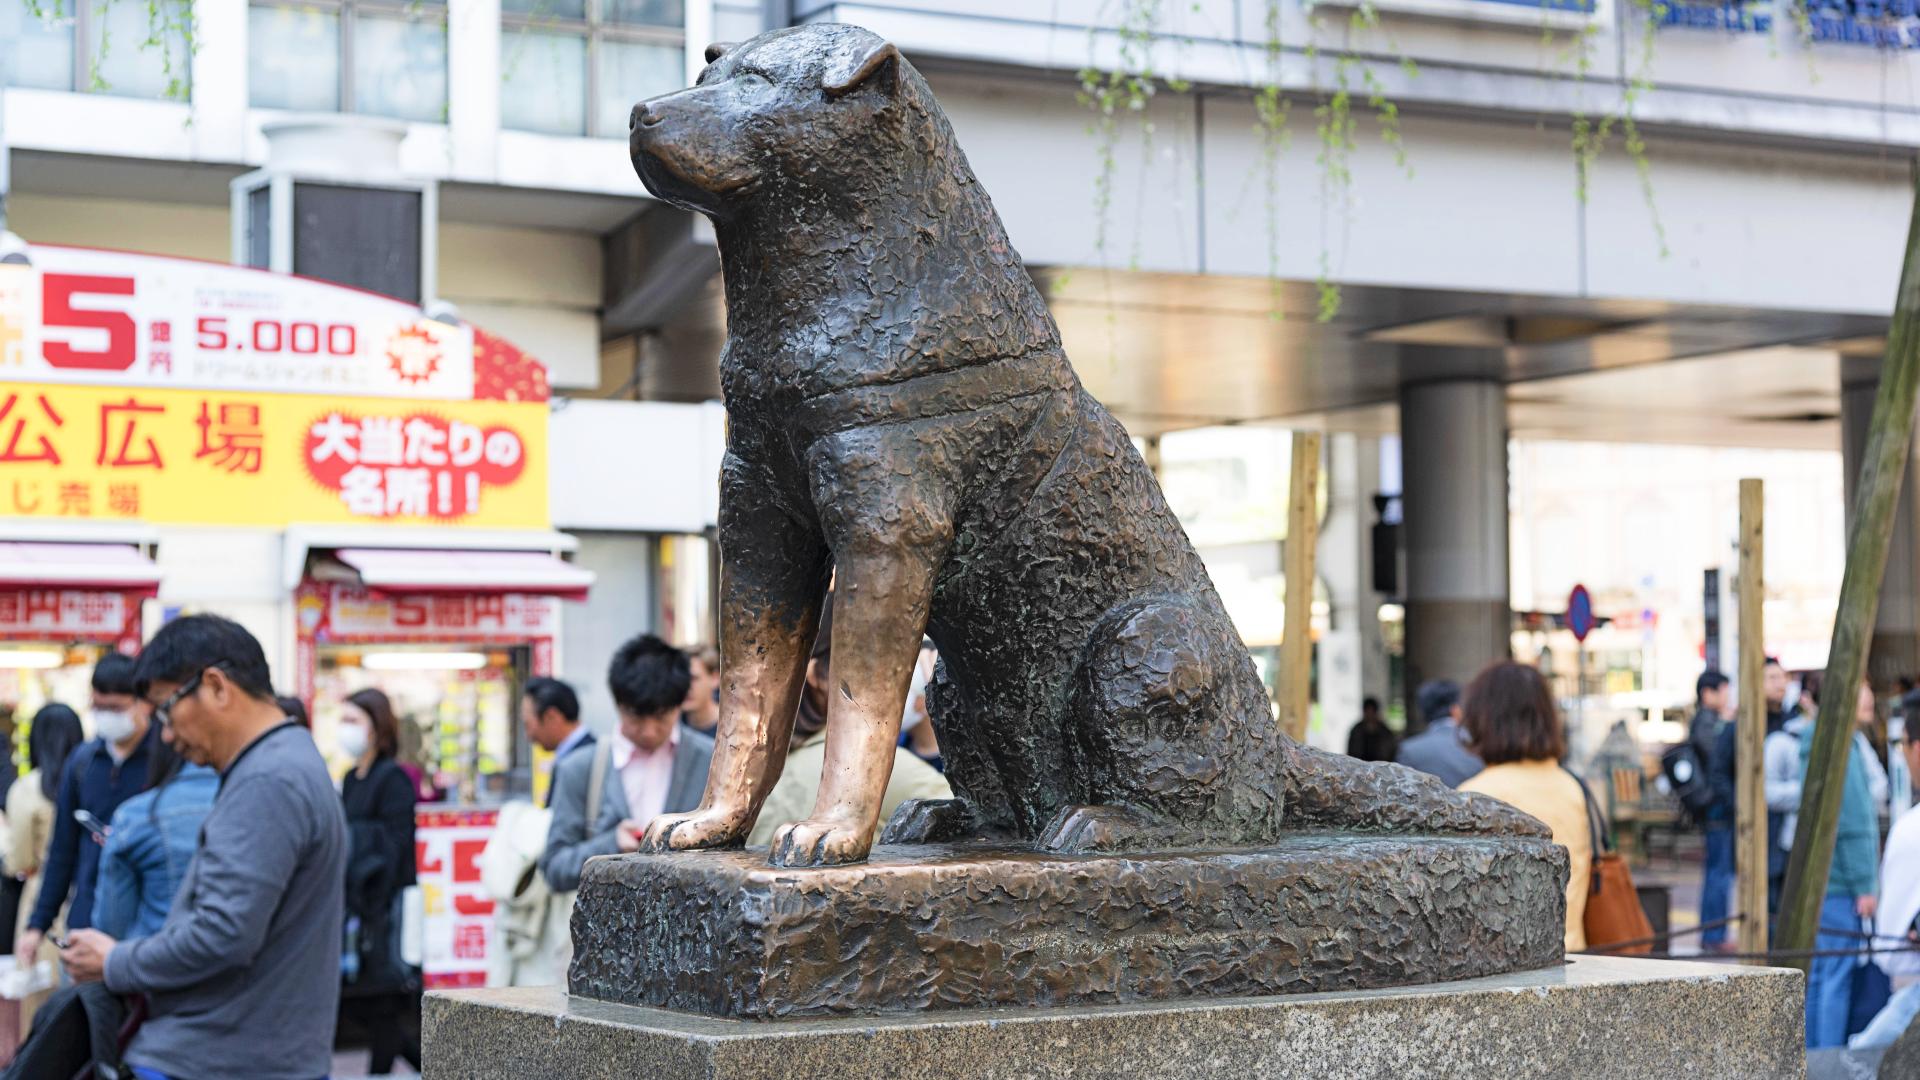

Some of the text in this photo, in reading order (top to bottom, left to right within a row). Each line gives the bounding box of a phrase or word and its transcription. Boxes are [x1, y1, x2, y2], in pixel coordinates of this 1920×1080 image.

[42, 272, 136, 370] 5
[197, 316, 356, 356] 5.000
[0, 394, 264, 474] 公広場
[311, 413, 521, 468] 大当たりの
[13, 480, 140, 516] じ売場
